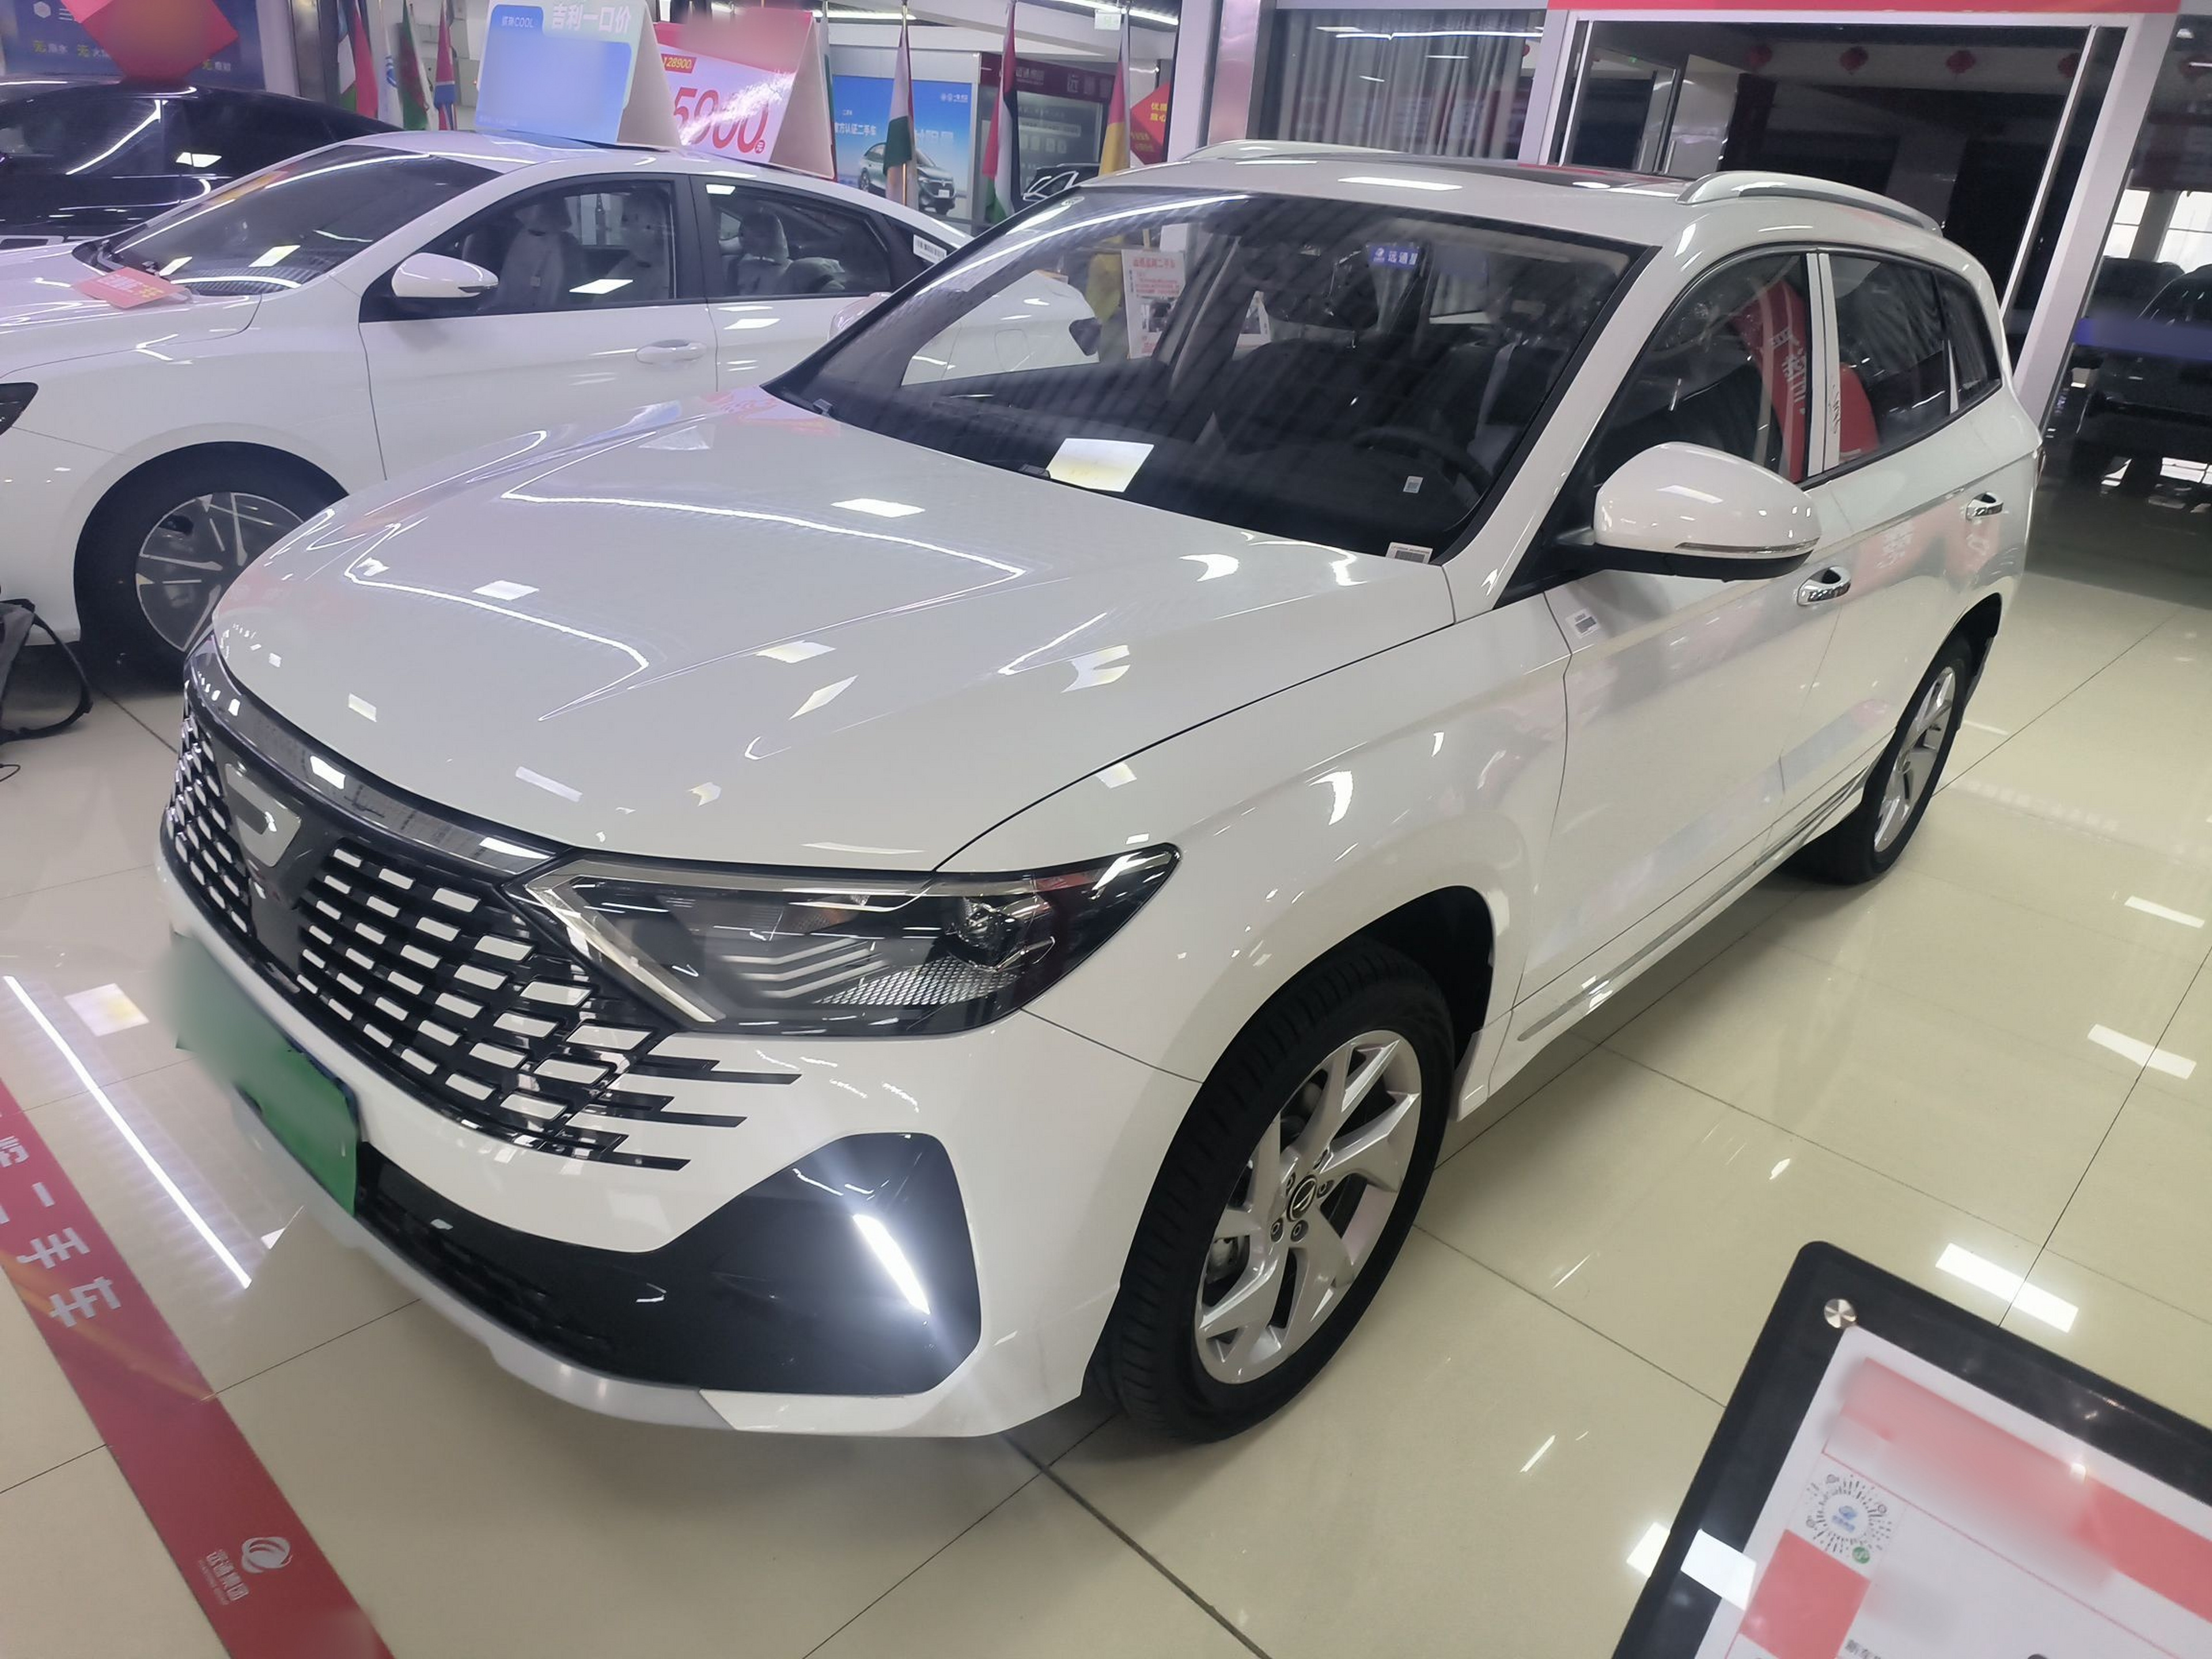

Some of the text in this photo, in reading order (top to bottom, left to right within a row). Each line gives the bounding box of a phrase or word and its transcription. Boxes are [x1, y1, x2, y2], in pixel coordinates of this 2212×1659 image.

[552, 3, 631, 33] 吉利一口价
